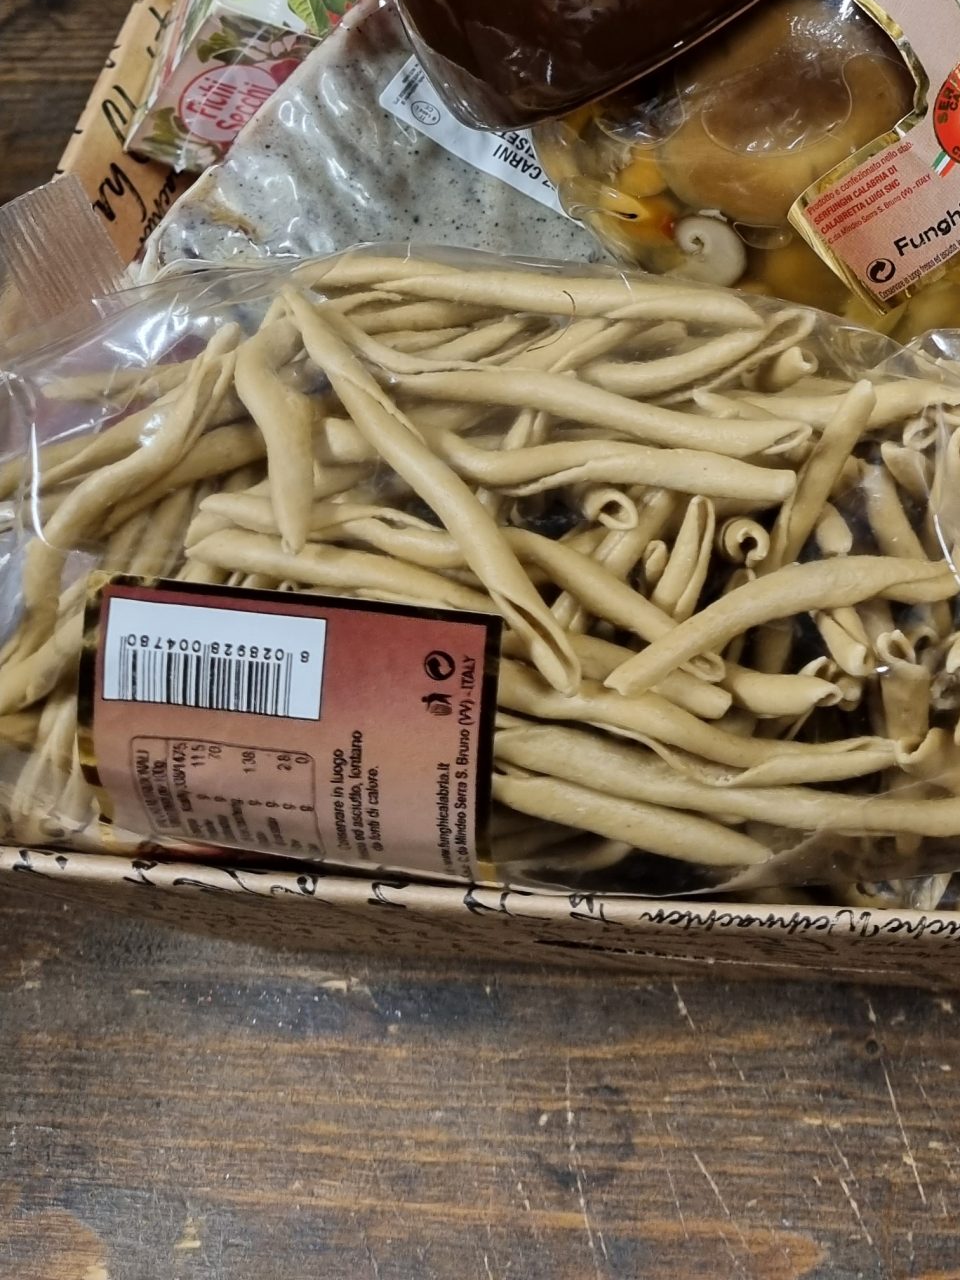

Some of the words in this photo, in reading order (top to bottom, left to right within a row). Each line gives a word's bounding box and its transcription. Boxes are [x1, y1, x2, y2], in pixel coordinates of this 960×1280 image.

[187, 77, 238, 119] Fichi
[216, 81, 276, 131] Secchi
[492, 145, 542, 180] CARNI
[804, 190, 837, 215] Prodotto
[836, 159, 883, 192] confezionato
[879, 149, 898, 165] nello
[811, 193, 855, 225] SERFUNGHI
[851, 169, 891, 198] CALABRIA
[887, 164, 898, 175] DI
[860, 207, 879, 223] Serra
[876, 202, 885, 212] S.
[883, 193, 902, 208] Bruno
[913, 172, 932, 187] ITALY
[817, 199, 868, 235] CALABRETTA
[863, 188, 885, 206] LUIGI
[881, 177, 901, 193] SNC
[127, 634, 201, 653] 004780
[211, 642, 285, 662] 028928
[300, 651, 310, 663] 8
[461, 655, 476, 689] ITALY
[458, 700, 474, 726] (VV)
[348, 730, 362, 778] lontano
[456, 729, 470, 765] Bruno
[330, 749, 347, 783] luogo
[455, 769, 468, 778] S.
[330, 787, 344, 797] in
[365, 766, 379, 804] calore.
[455, 782, 468, 809] Serra
[348, 783, 364, 827] asciutto,
[364, 808, 379, 817] di
[352, 830, 365, 840] ed
[367, 821, 381, 840] fonti
[455, 812, 468, 845] Mindeo
